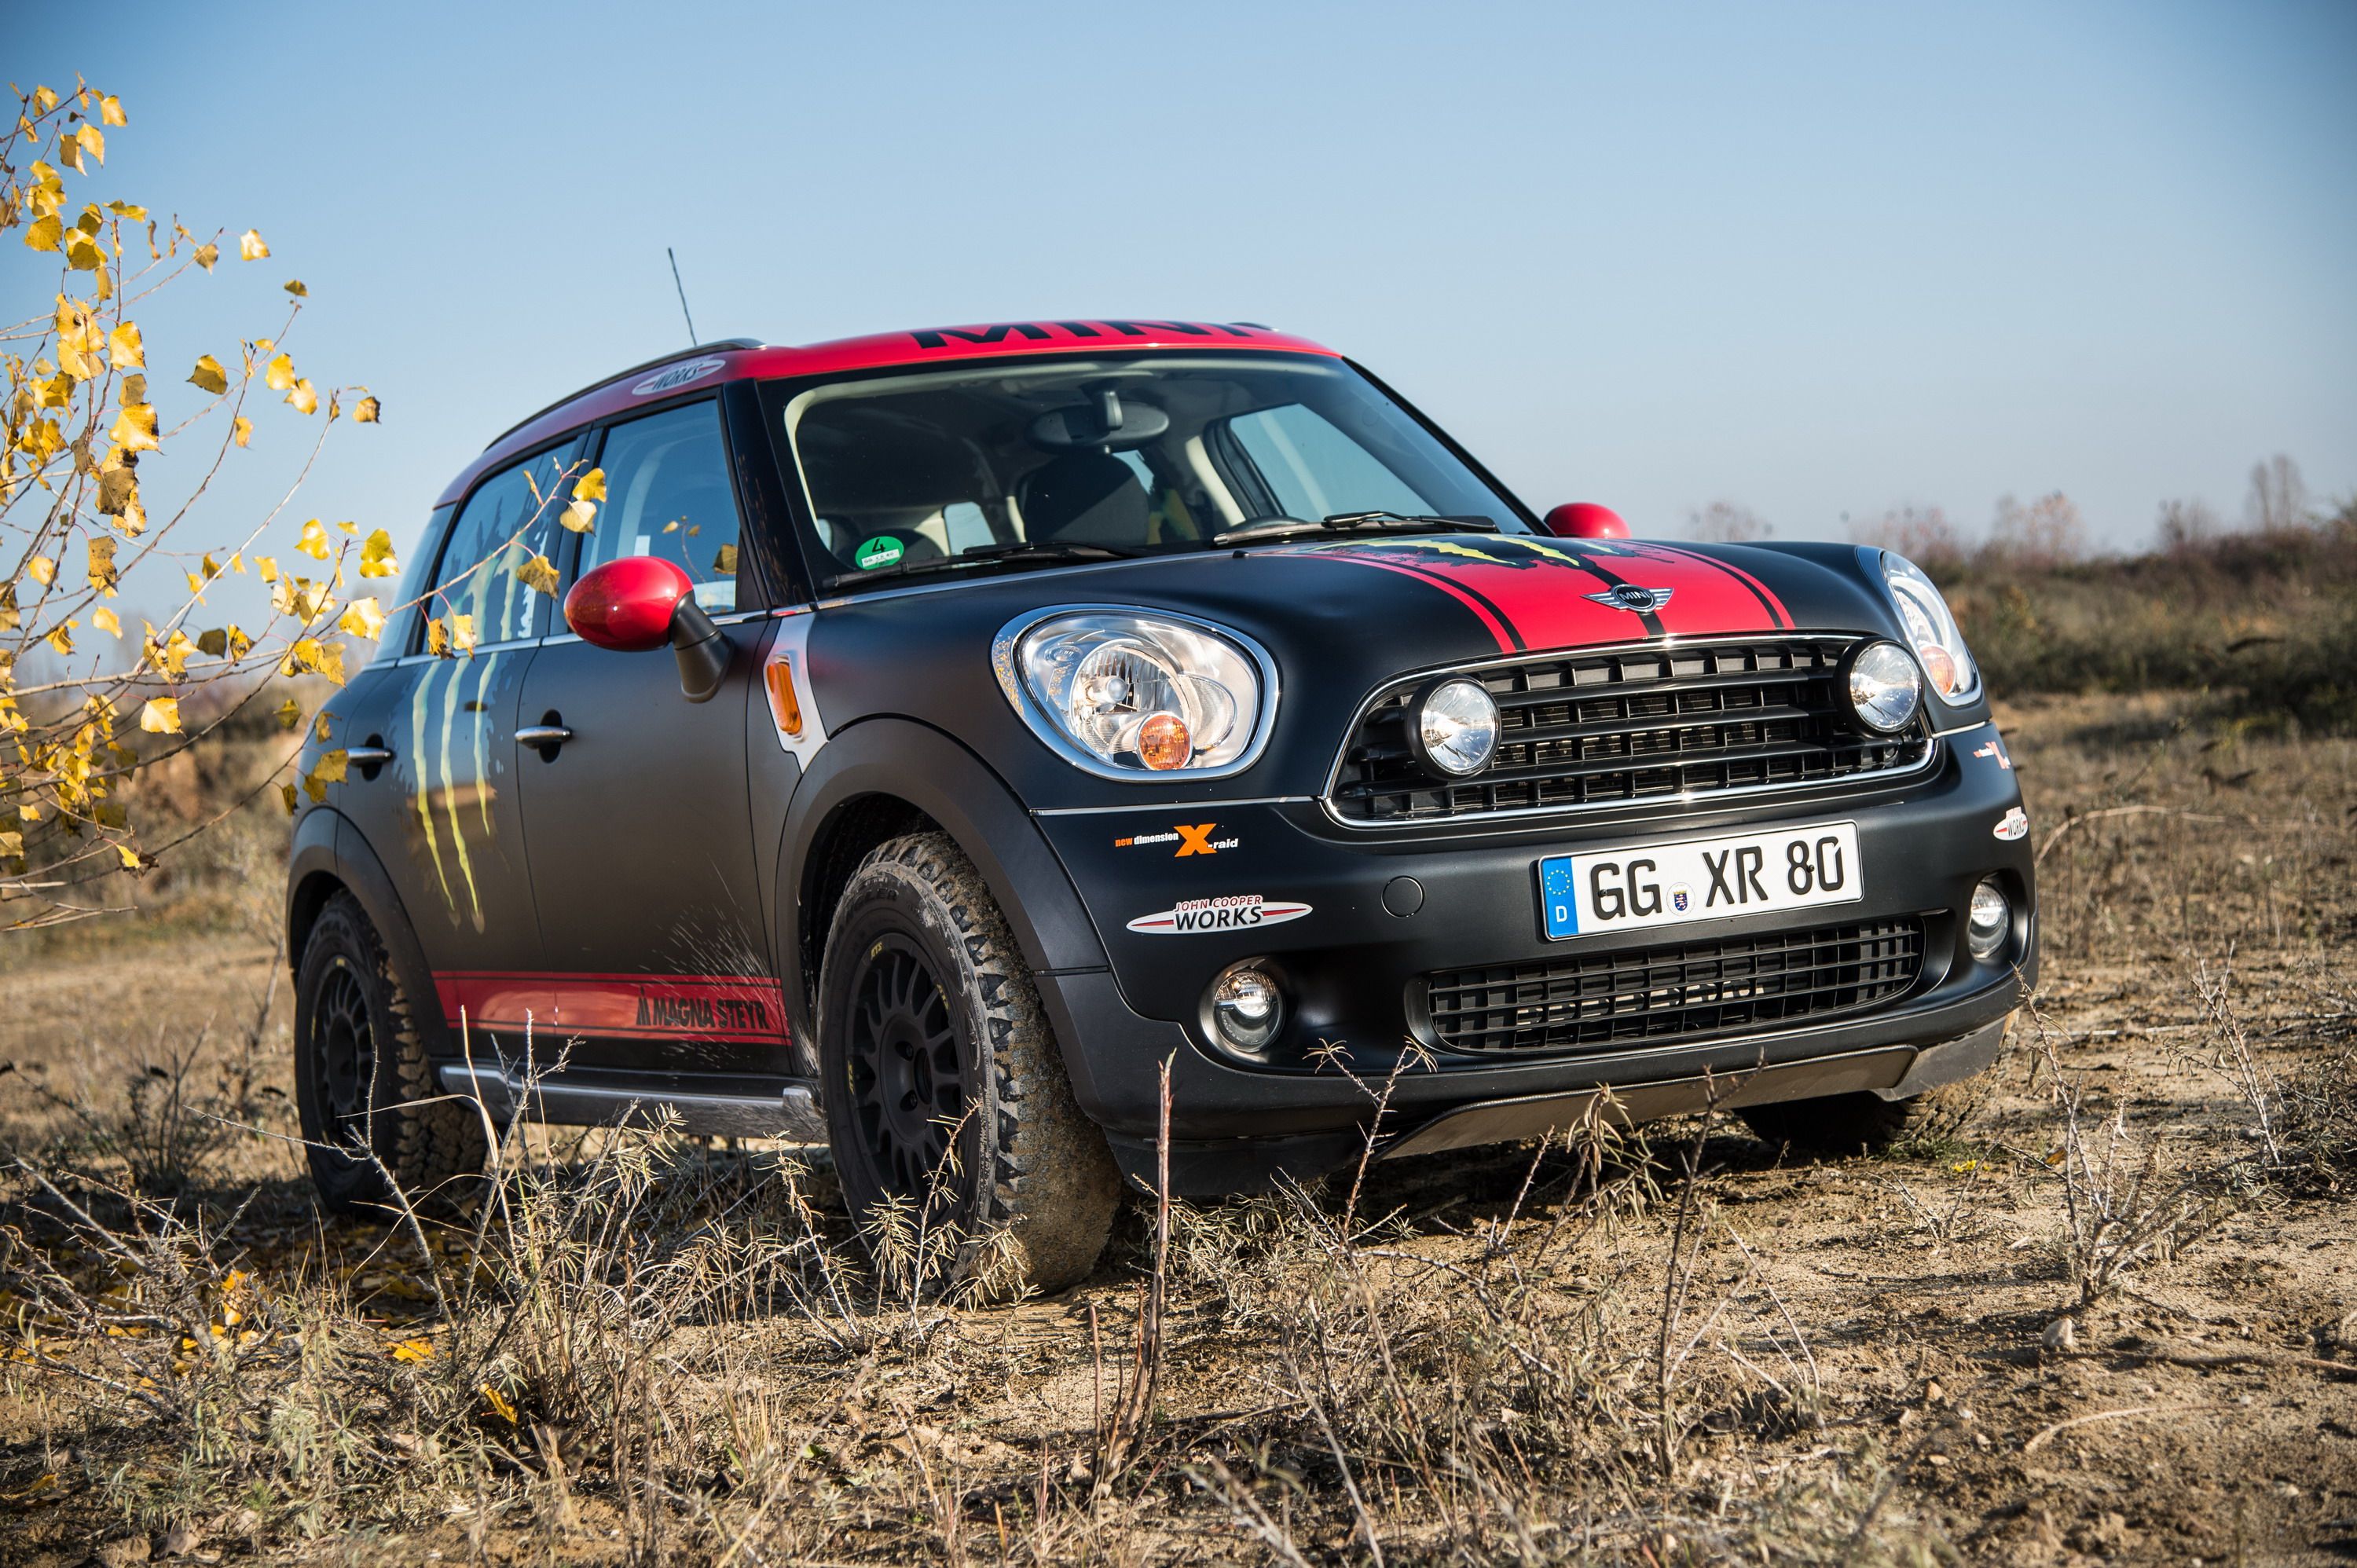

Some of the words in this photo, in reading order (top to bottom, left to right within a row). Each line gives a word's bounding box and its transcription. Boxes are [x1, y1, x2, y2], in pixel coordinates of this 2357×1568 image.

[909, 319, 1255, 349] MINI
[871, 537, 886, 552] 4
[1618, 591, 1651, 601] MINI
[1115, 837, 1133, 848] new
[1134, 833, 1179, 844] dimension
[1556, 905, 1567, 923] D
[1589, 858, 1662, 921] GG
[1702, 844, 1769, 907] XR
[1786, 836, 1845, 896] 80
[1174, 898, 1211, 912] JOHN
[1213, 895, 1263, 909] COOPER
[1175, 906, 1263, 932] WORKS
[653, 997, 716, 1028] MAGNA
[716, 998, 771, 1030] STEYR
